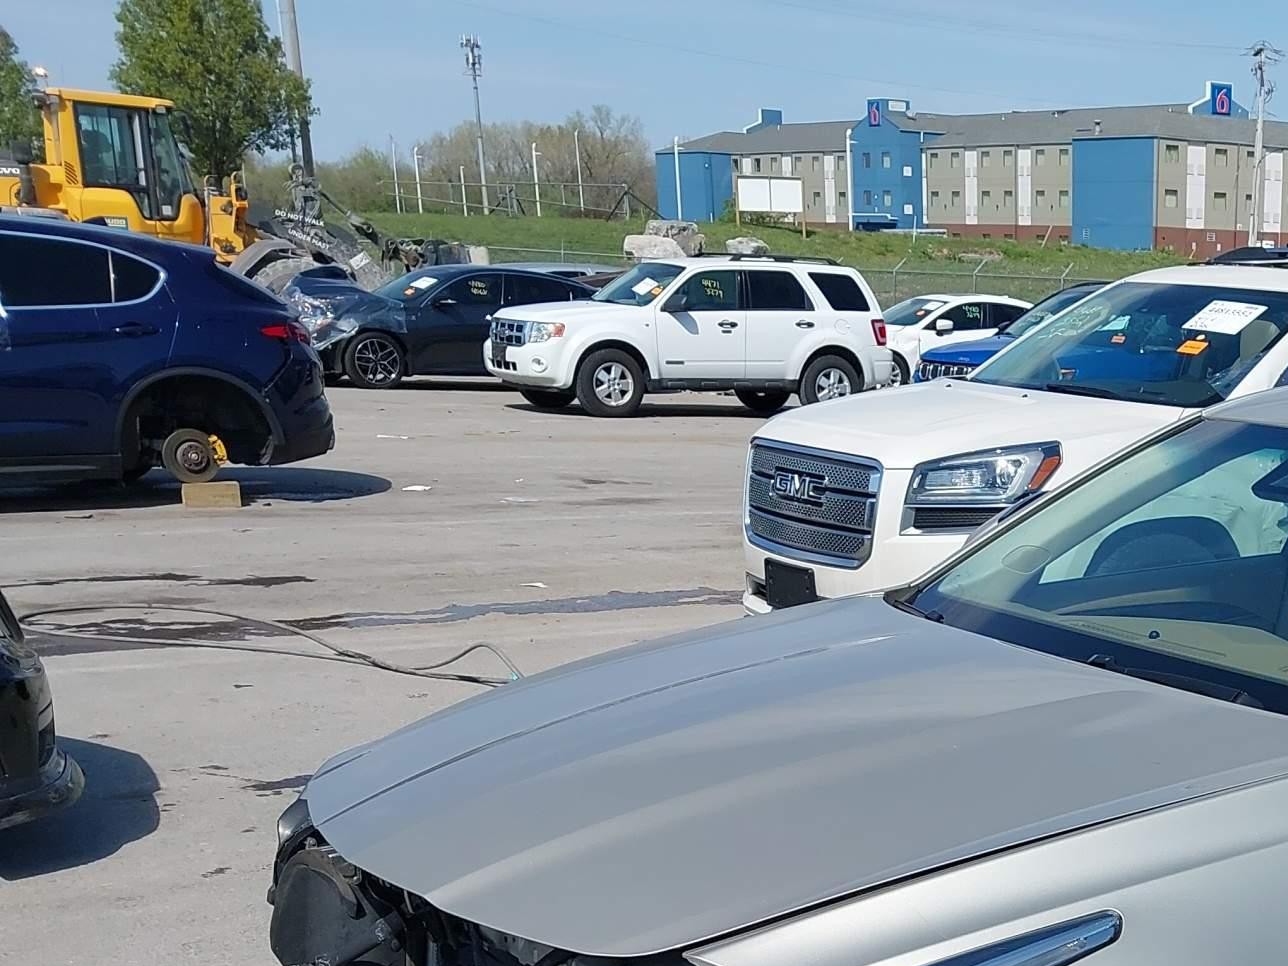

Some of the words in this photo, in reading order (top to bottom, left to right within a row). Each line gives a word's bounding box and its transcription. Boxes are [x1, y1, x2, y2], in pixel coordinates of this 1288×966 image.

[1215, 88, 1229, 114] 6
[871, 102, 880, 126] 6
[275, 208, 287, 217] DO
[287, 213, 303, 221] NOT
[304, 215, 325, 227] WALK
[288, 228, 311, 242] UNDER
[311, 239, 330, 250] MAST
[774, 472, 826, 500] GMC
